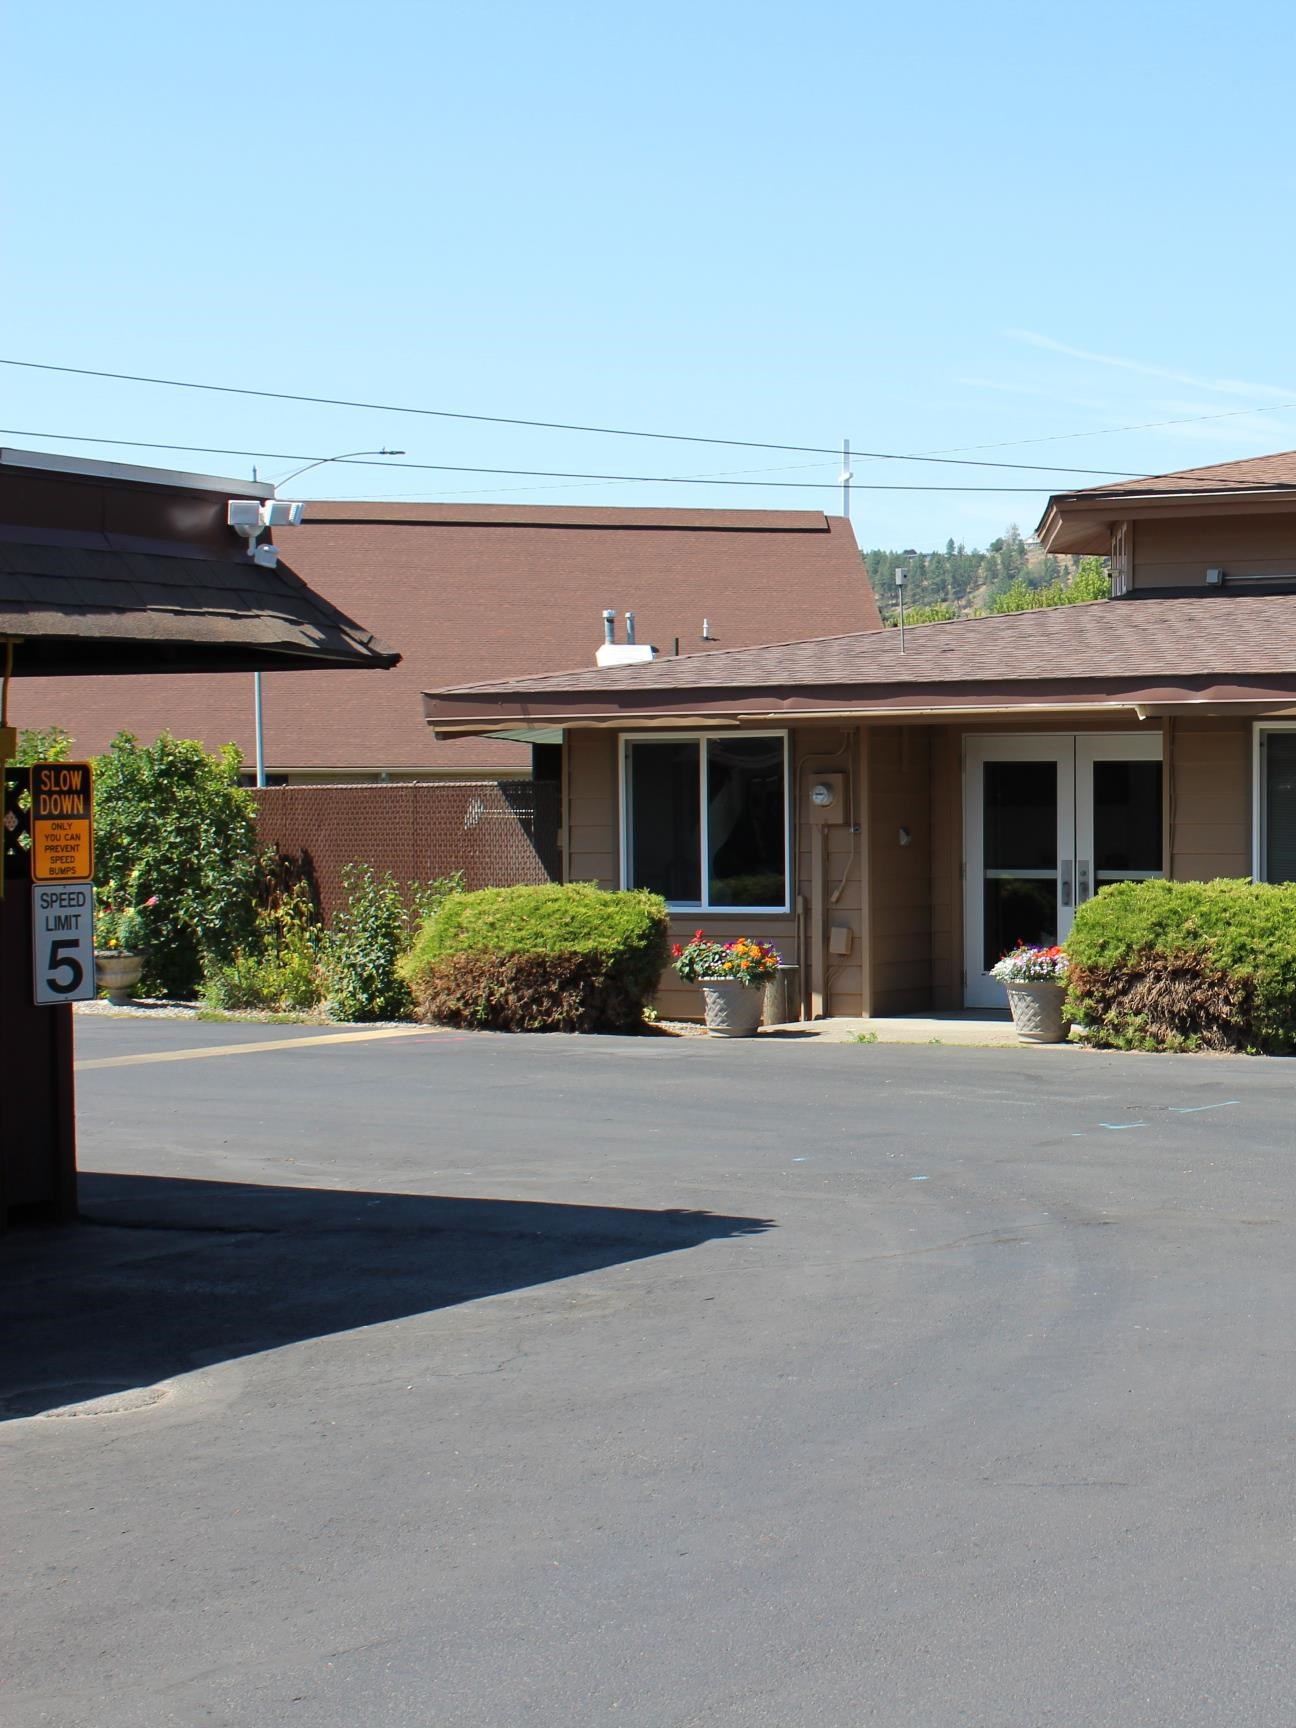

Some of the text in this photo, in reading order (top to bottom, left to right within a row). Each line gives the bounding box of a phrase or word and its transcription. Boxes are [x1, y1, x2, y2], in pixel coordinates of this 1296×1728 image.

[41, 770, 82, 791] SLOW
[40, 794, 84, 815] DOWN
[51, 822, 73, 831] ONLY
[44, 833, 81, 842] YOU CAN
[44, 844, 80, 854] PREVENT
[50, 855, 76, 864] SPEED
[48, 866, 77, 875] BUMPS
[40, 891, 86, 910] SPEED
[45, 914, 82, 931] LIMIT
[46, 938, 84, 995] 5
